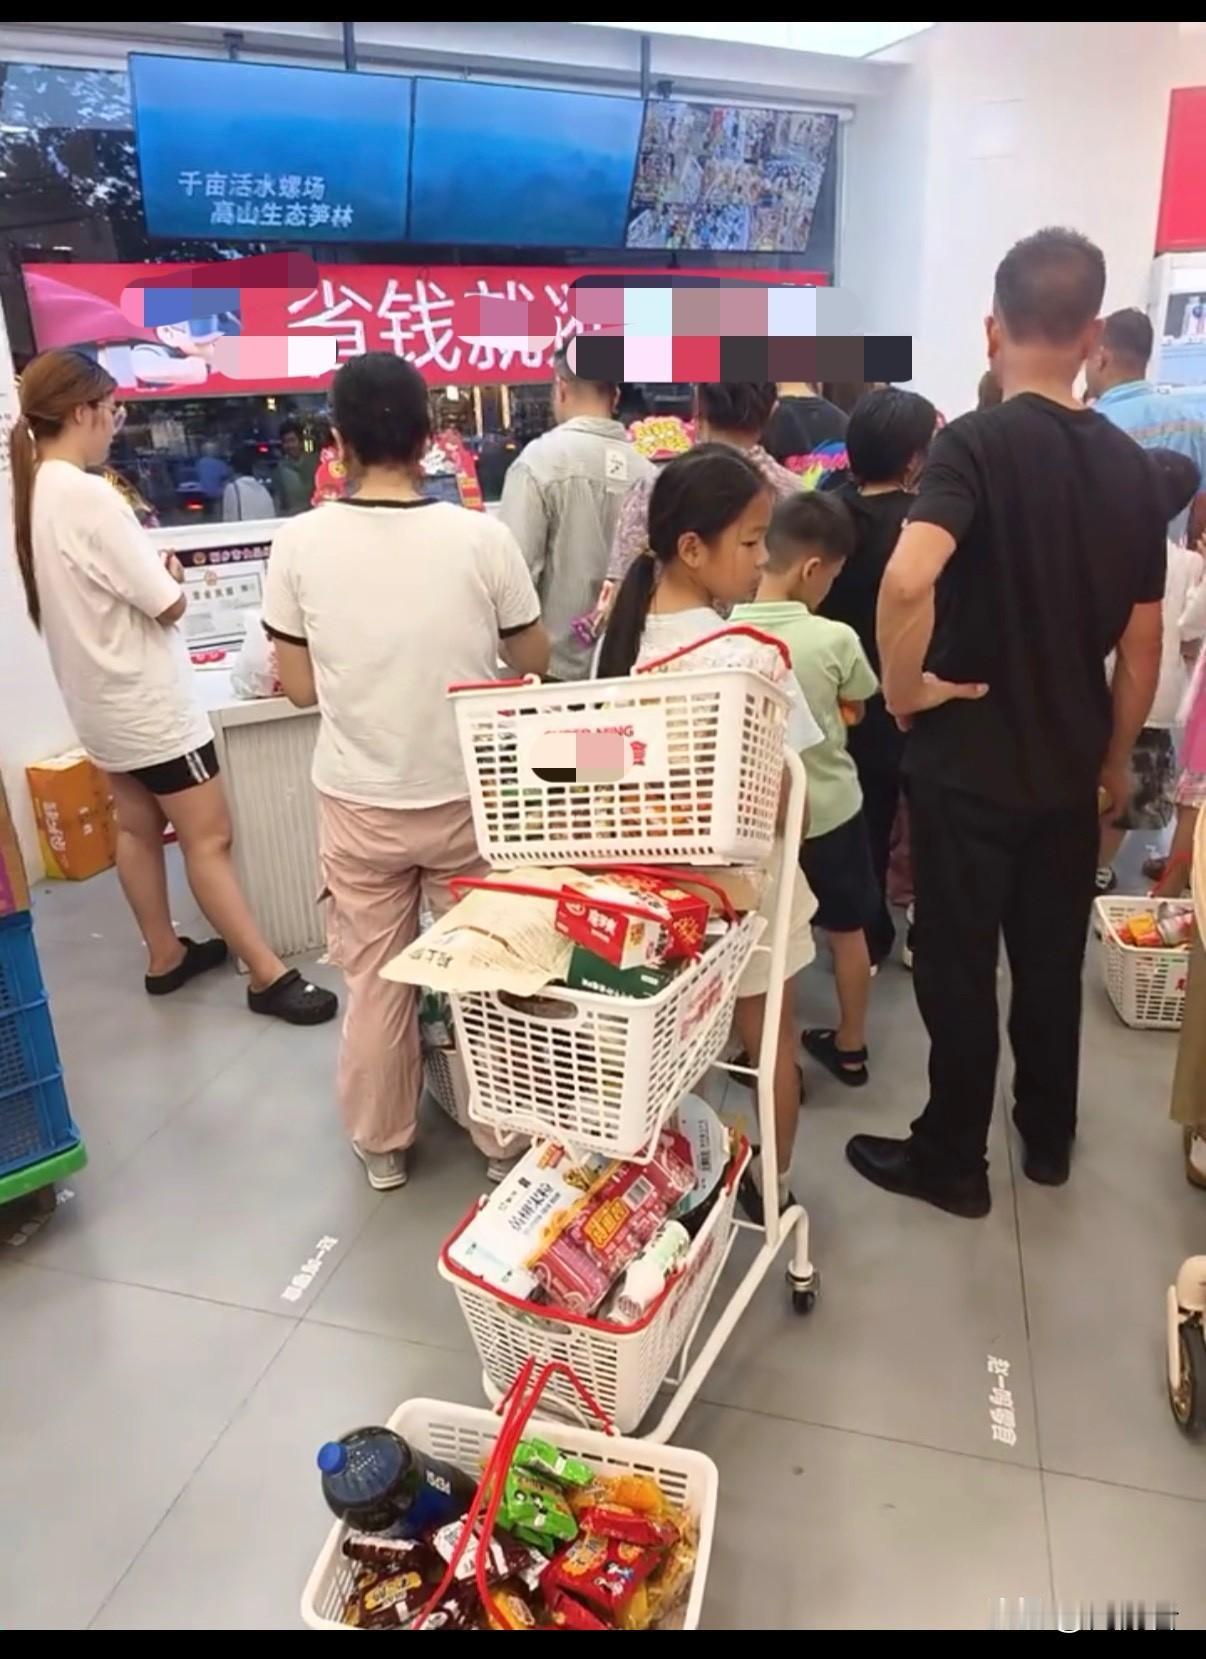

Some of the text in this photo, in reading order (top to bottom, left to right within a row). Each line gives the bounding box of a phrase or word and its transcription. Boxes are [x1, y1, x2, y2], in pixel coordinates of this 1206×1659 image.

[178, 170, 326, 200] 千亩活水螺场
[210, 200, 354, 230] 高山生态笋林
